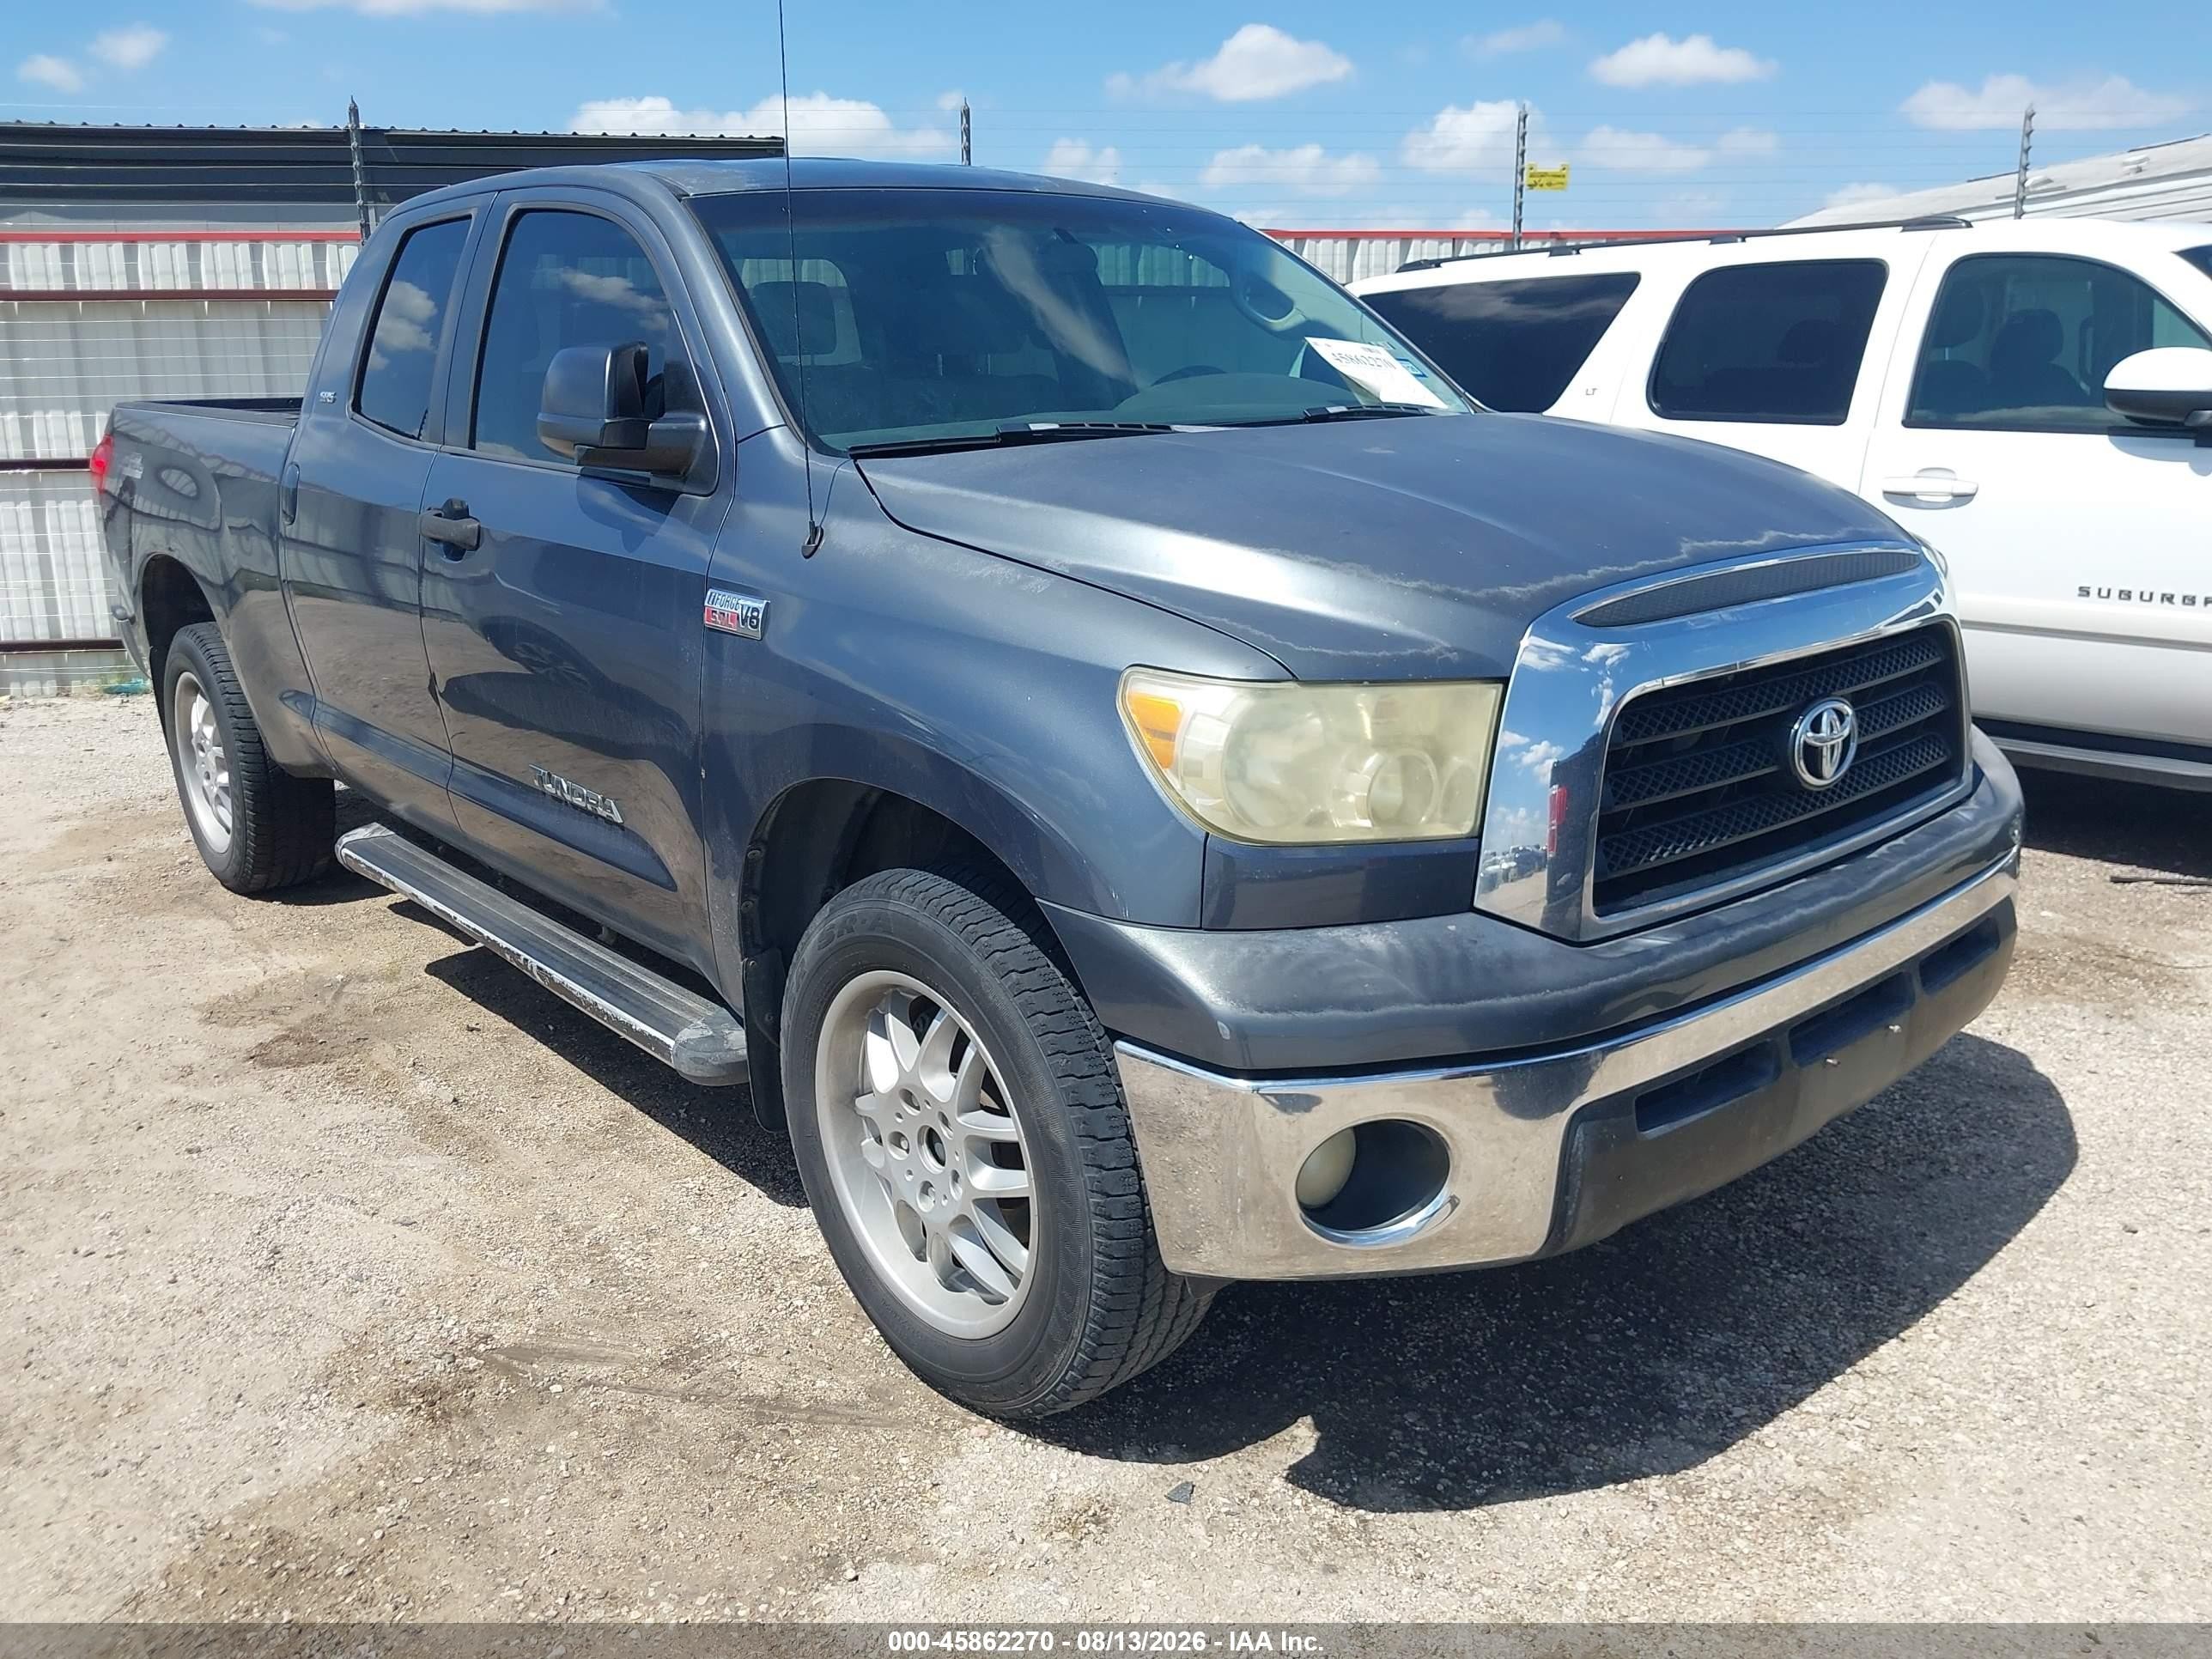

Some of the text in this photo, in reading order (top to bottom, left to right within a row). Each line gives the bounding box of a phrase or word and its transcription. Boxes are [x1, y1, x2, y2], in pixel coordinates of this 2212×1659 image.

[1585, 387, 1598, 396] LT
[739, 603, 761, 630] V8
[528, 763, 624, 823] TUNDRA
